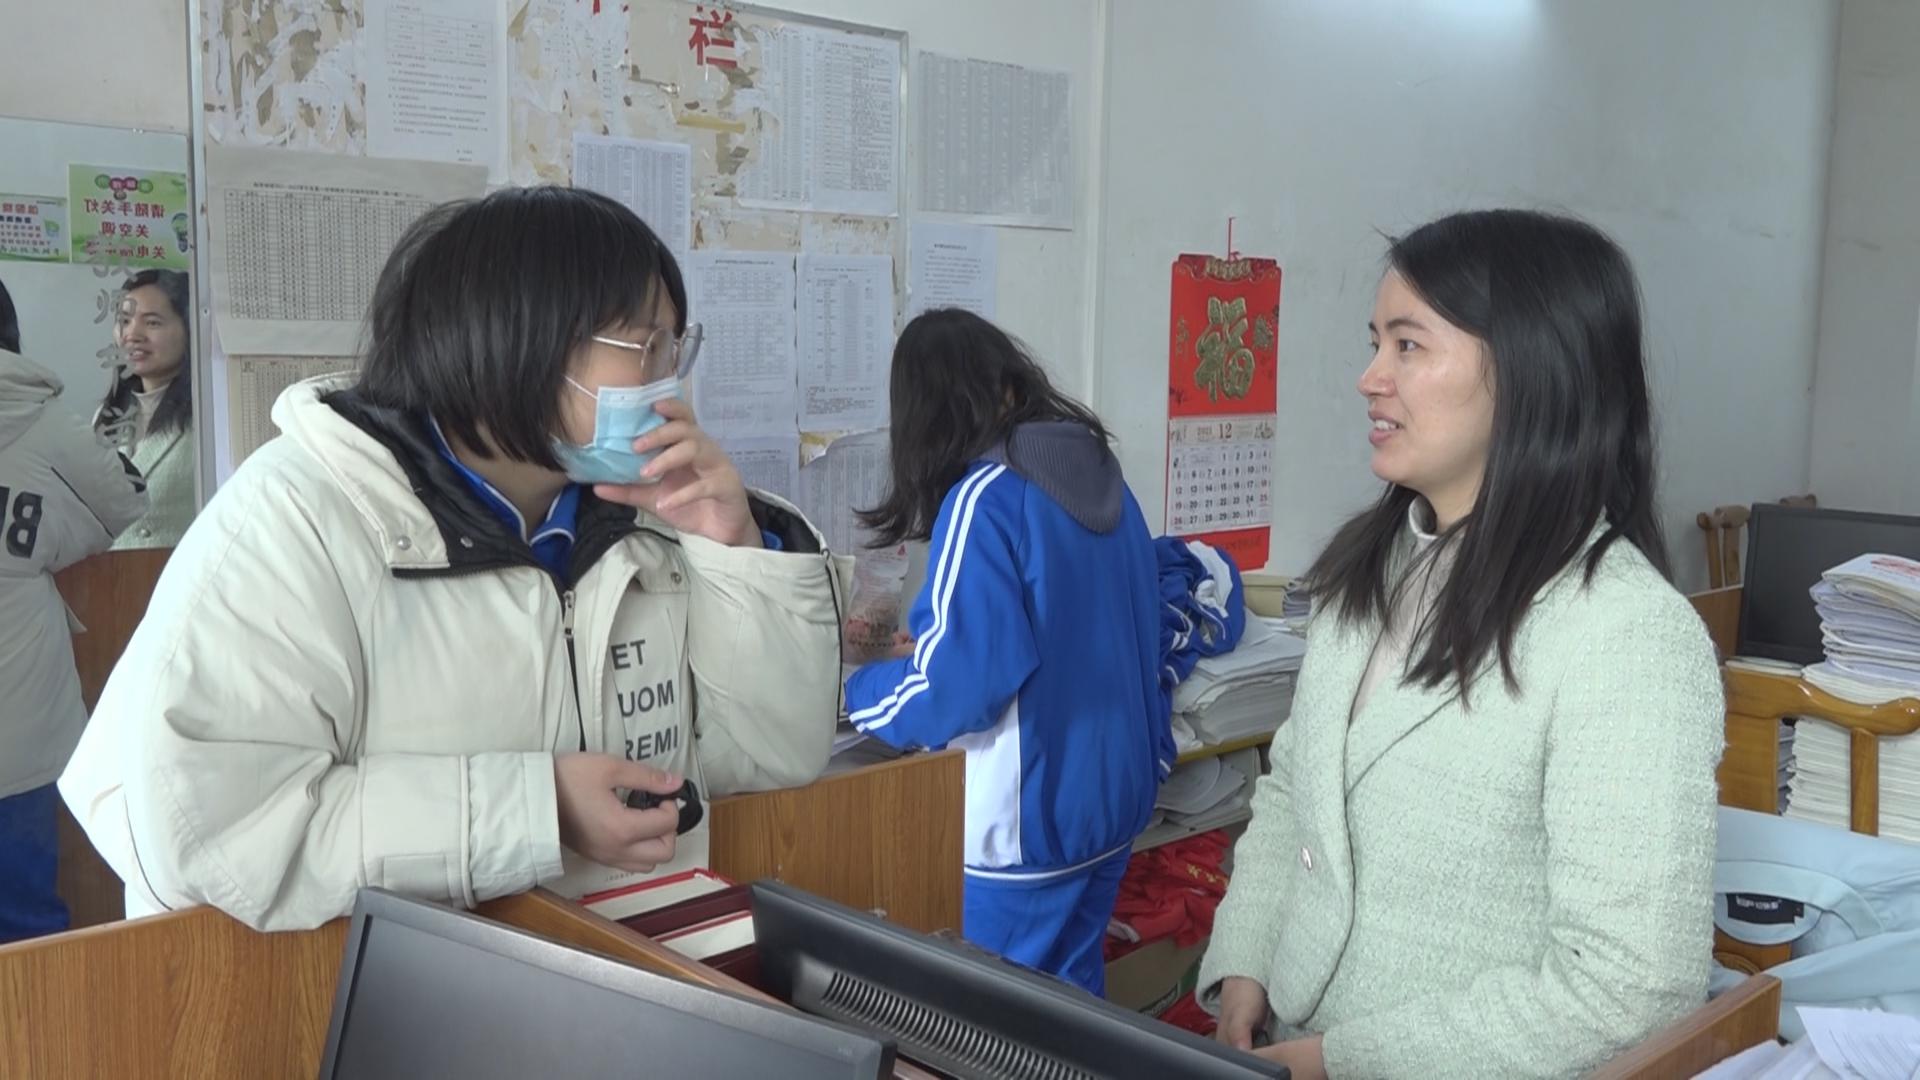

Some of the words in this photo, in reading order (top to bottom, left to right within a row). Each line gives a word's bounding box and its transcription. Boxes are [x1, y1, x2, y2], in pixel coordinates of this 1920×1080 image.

[689, 5, 737, 69] 栏
[1219, 422, 1232, 440] 12
[1247, 465, 1254, 474] 10
[1261, 464, 1267, 473] 11
[1175, 486, 1182, 495] 12
[1190, 484, 1197, 493] 13
[1205, 484, 1212, 492] 14
[1220, 482, 1227, 491] 15
[1233, 481, 1240, 489] 16
[1247, 480, 1254, 488] 17
[1175, 501, 1182, 510] 19
[1189, 500, 1198, 509] 20
[1205, 499, 1212, 508] 21
[1219, 497, 1227, 506] 22
[1233, 496, 1240, 504] 23
[1246, 495, 1254, 504] 24
[1174, 516, 1182, 525] 26
[1189, 515, 1197, 524] 27
[1205, 513, 1212, 522] 28
[1219, 512, 1227, 520] 29
[1232, 511, 1240, 519] 30
[1247, 509, 1254, 517] 31
[610, 639, 646, 670] ET
[617, 679, 674, 718] UOM
